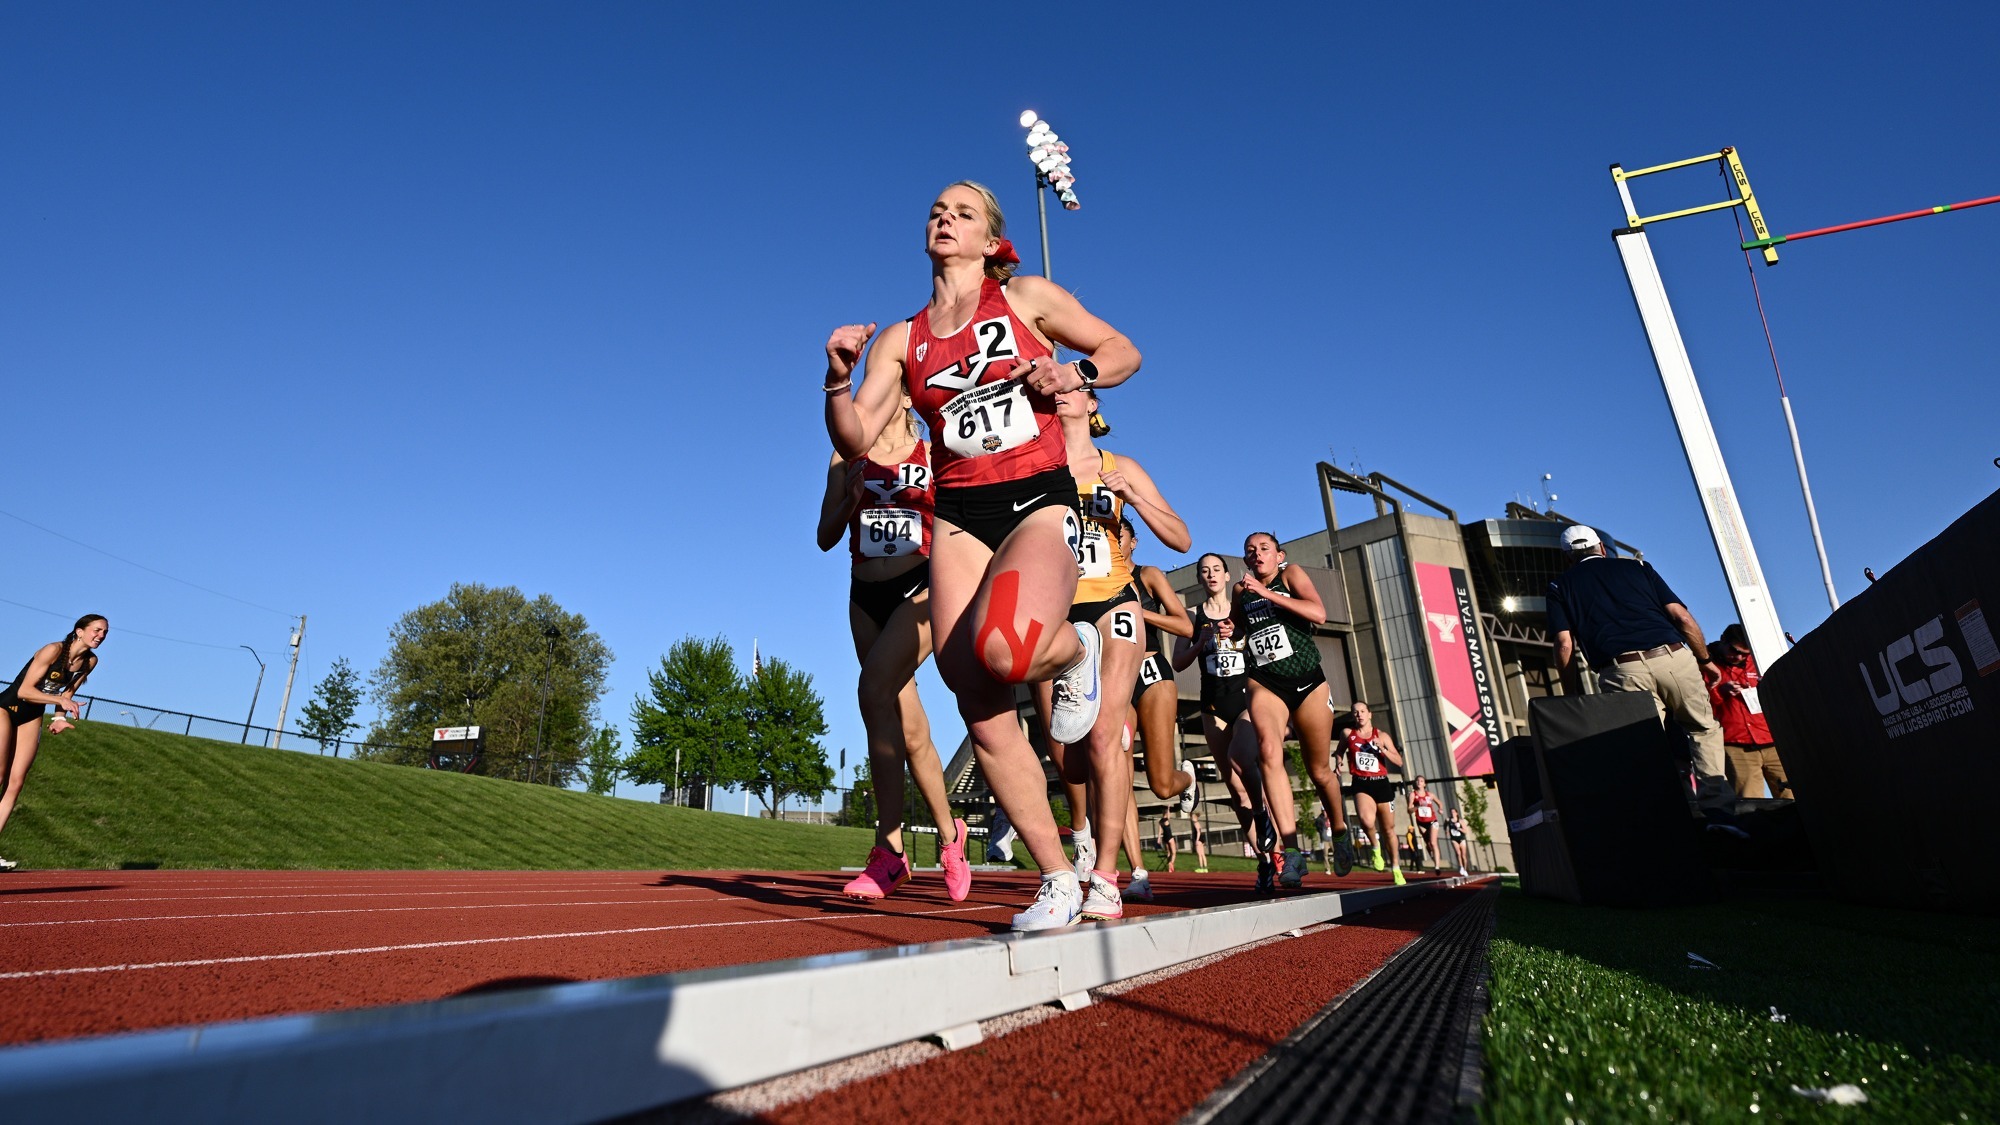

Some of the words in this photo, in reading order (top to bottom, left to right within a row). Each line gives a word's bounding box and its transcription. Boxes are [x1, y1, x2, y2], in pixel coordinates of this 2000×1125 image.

[1733, 163, 1748, 186] UCS
[1751, 210, 1766, 235] UCS
[979, 321, 1013, 359] 2
[958, 397, 1013, 439] 617
[901, 464, 927, 489] 12
[1096, 485, 1112, 515] 5
[869, 520, 912, 543] 604
[1247, 607, 1277, 625] STATE
[1456, 587, 1475, 635] STATE
[1114, 612, 1133, 638] 5
[1255, 634, 1284, 655] 542
[1143, 659, 1157, 681] 4
[1212, 655, 1237, 668] 187
[1858, 616, 1963, 716] UCS
[1886, 697, 1975, 740] WWW.UCSSPIRIT.COM
[1359, 756, 1376, 767] 627
